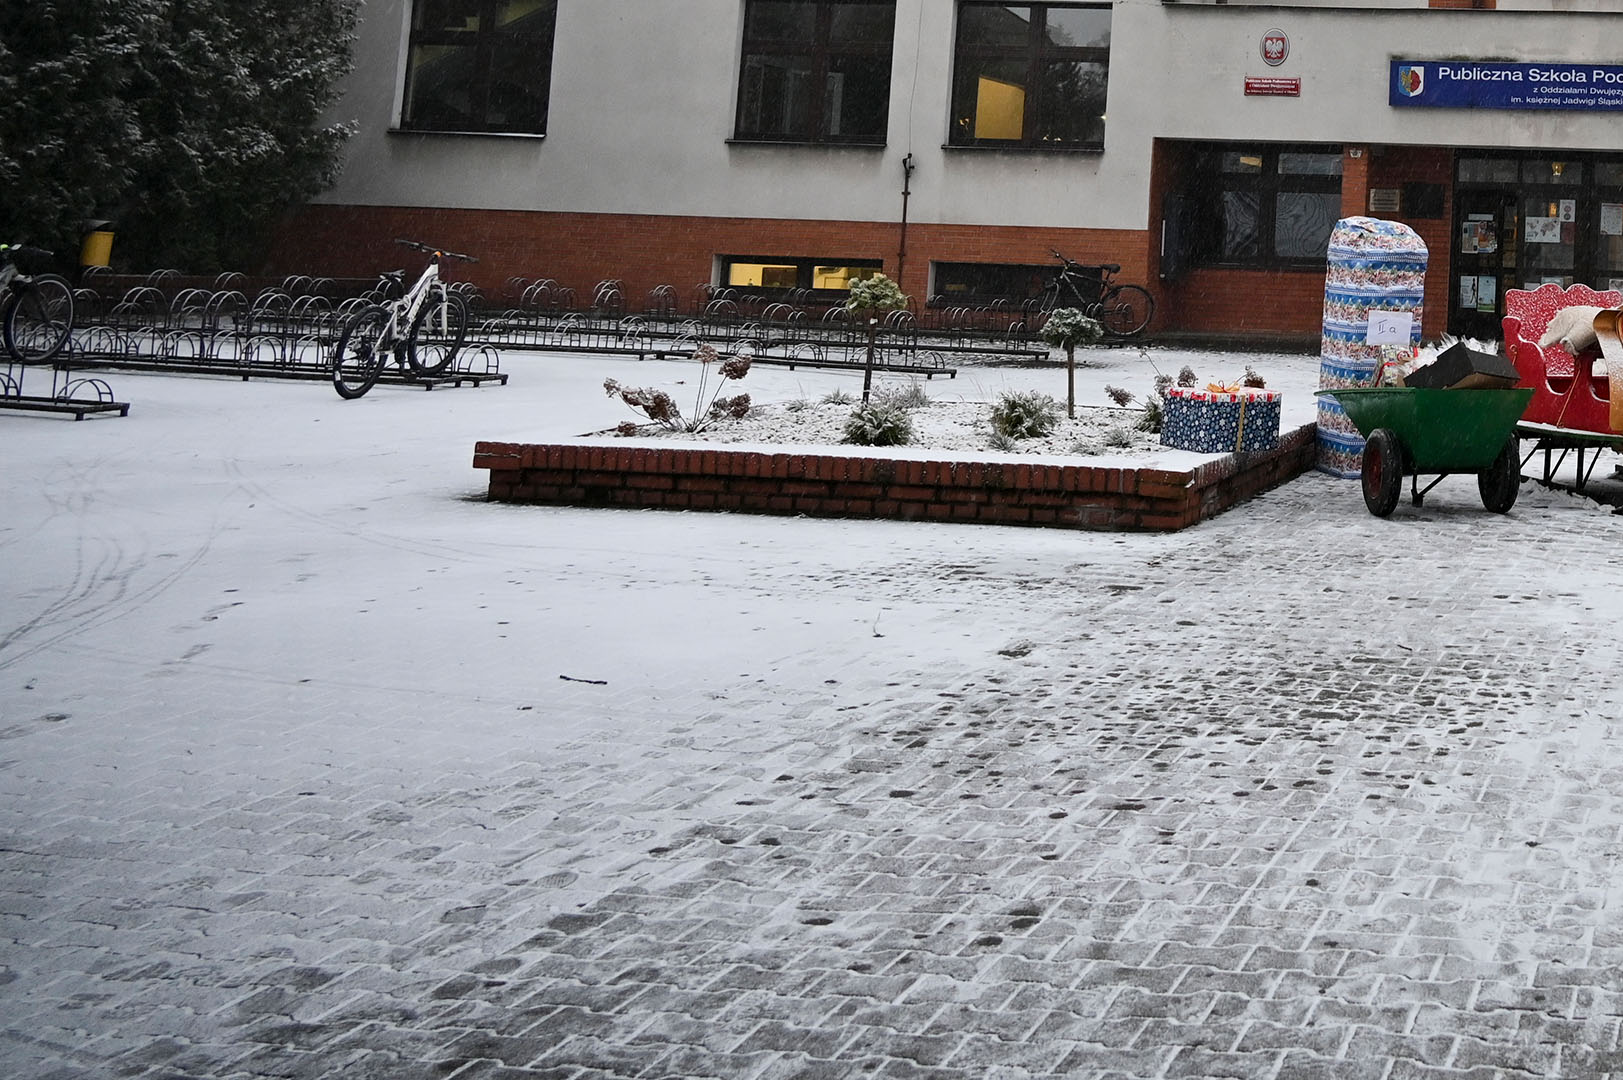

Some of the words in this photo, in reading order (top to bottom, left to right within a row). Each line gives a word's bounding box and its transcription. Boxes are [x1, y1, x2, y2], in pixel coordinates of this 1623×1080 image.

[1438, 66, 1523, 81] Publiczna
[1528, 68, 1587, 83] Szkoła
[1540, 86, 1588, 94] Oddziałami
[1563, 97, 1596, 106] Jadwigi
